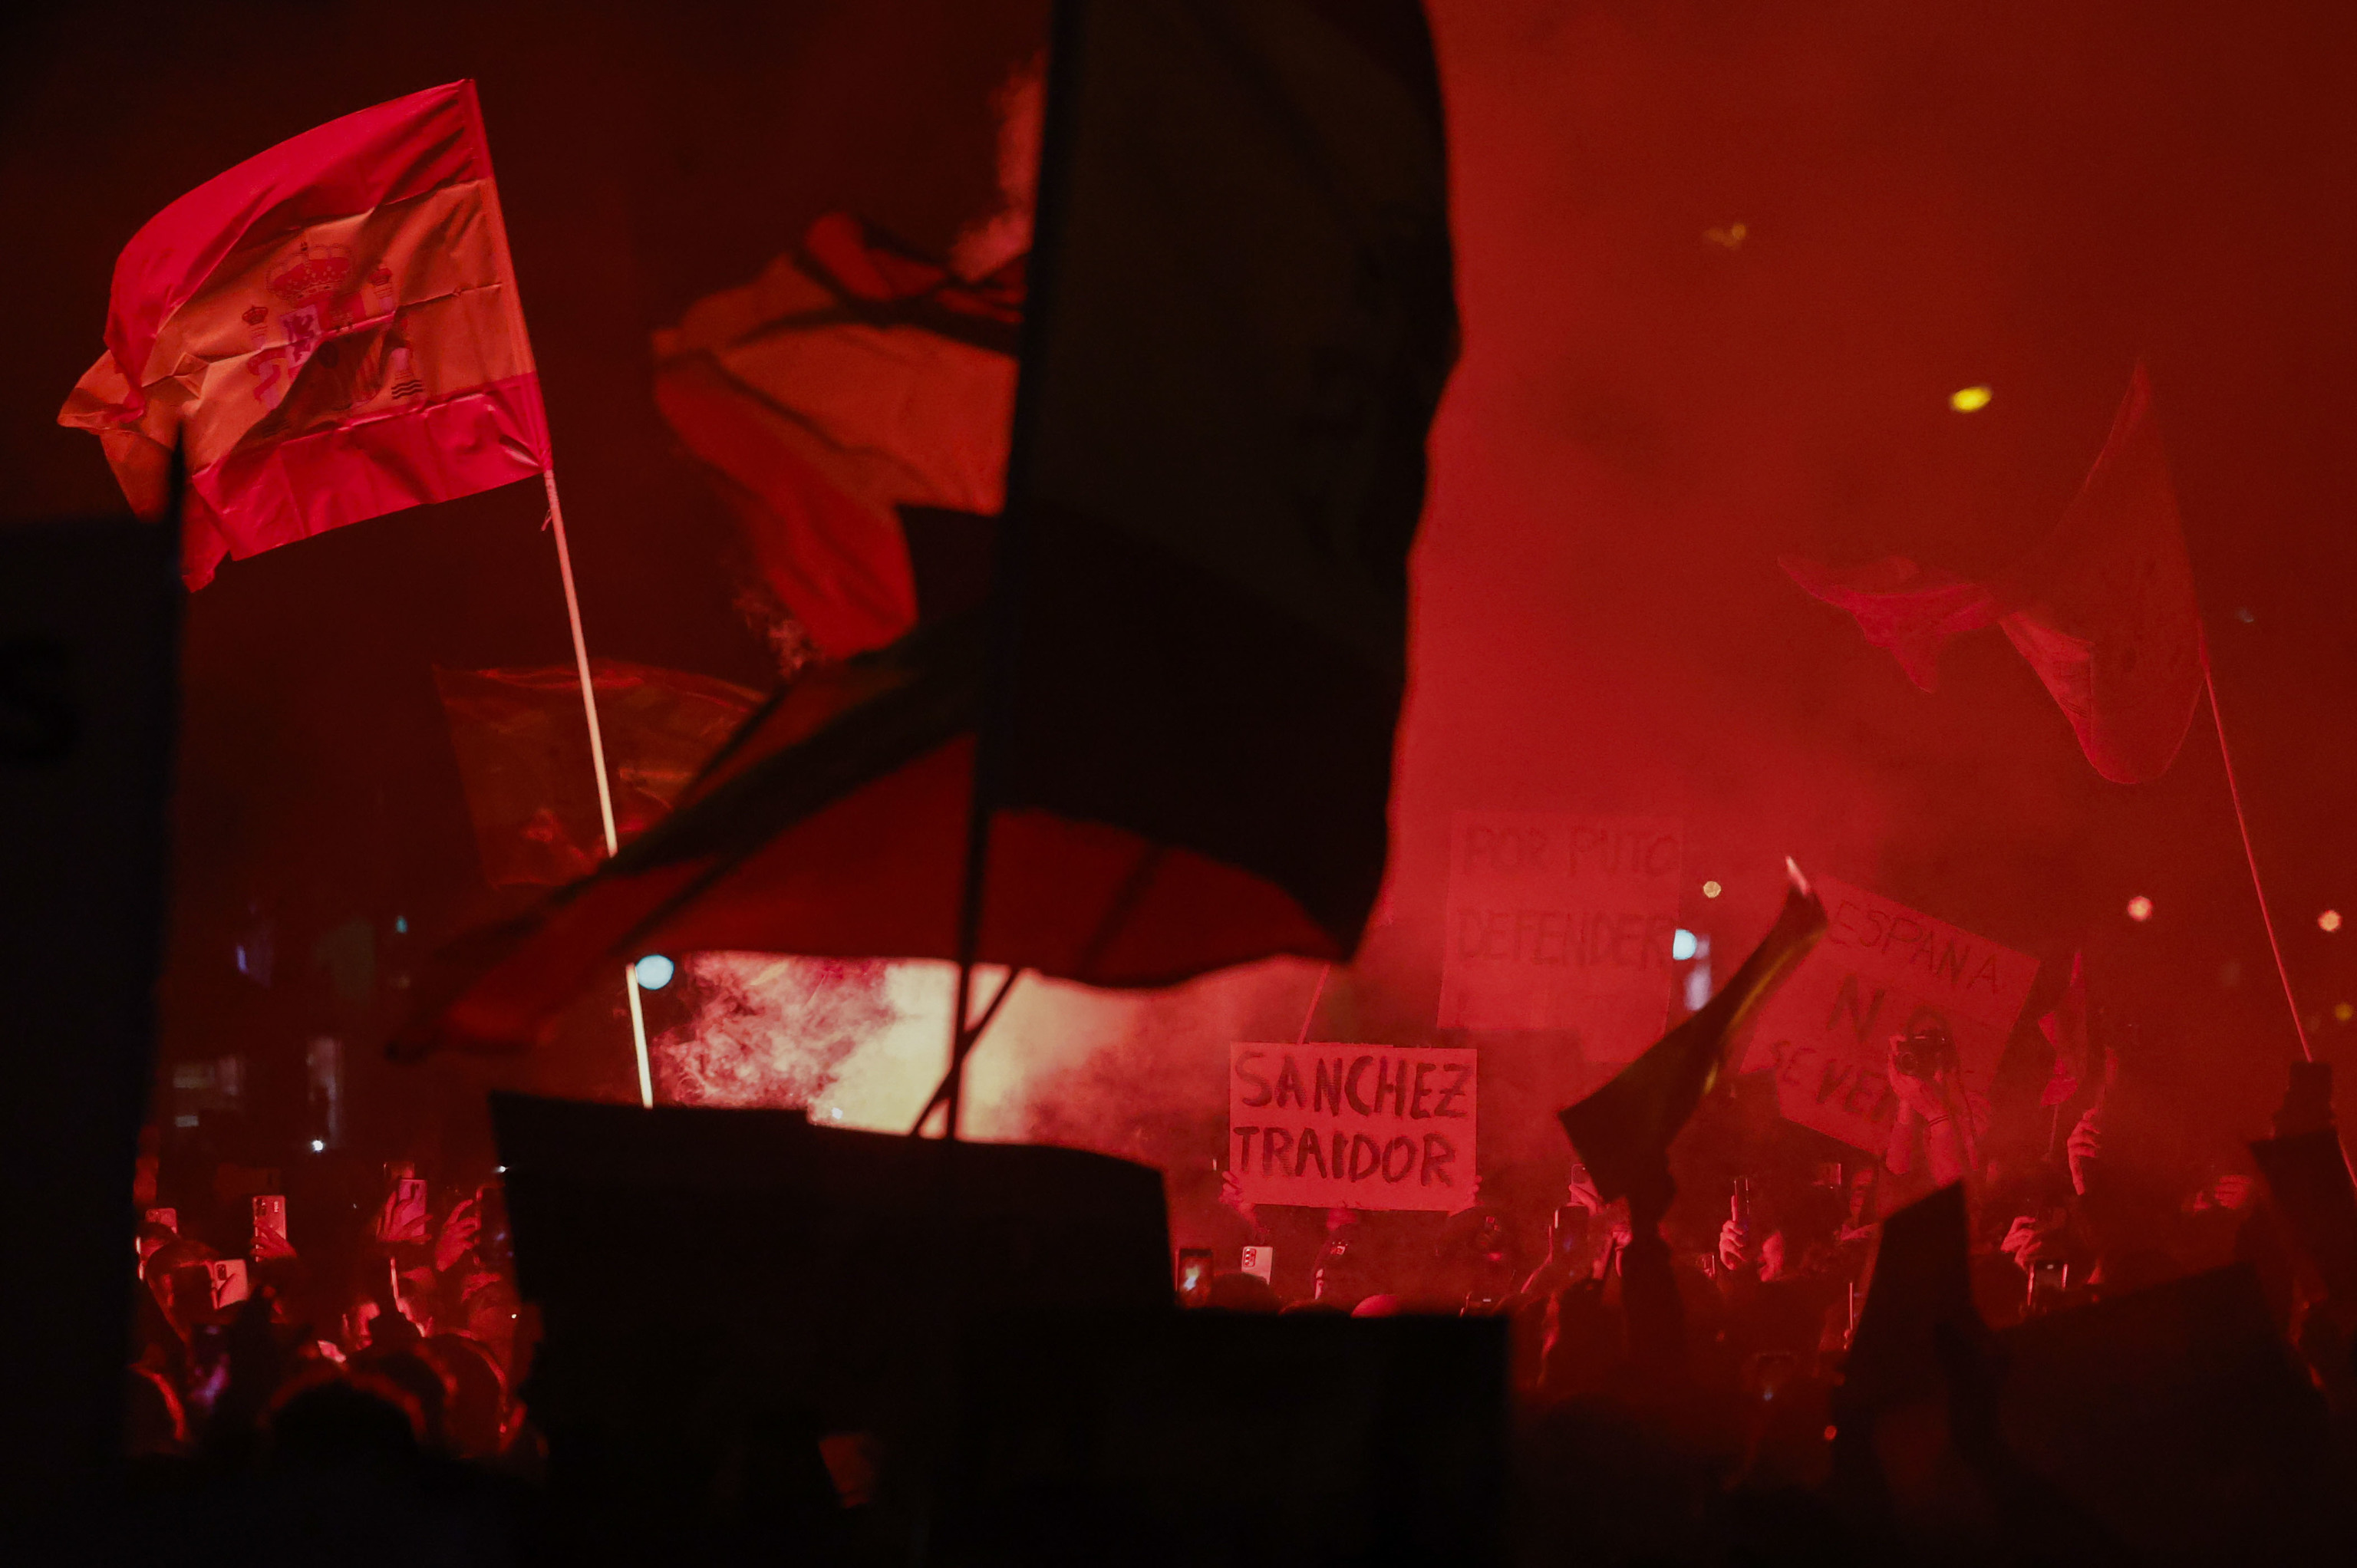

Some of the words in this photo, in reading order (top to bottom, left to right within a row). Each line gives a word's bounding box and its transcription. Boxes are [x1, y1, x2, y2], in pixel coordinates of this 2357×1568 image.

[1456, 908, 1680, 971] DEFENDER
[1235, 1050, 1472, 1119] SANCHEZ
[1233, 1125, 1456, 1187] TRAIDOR
